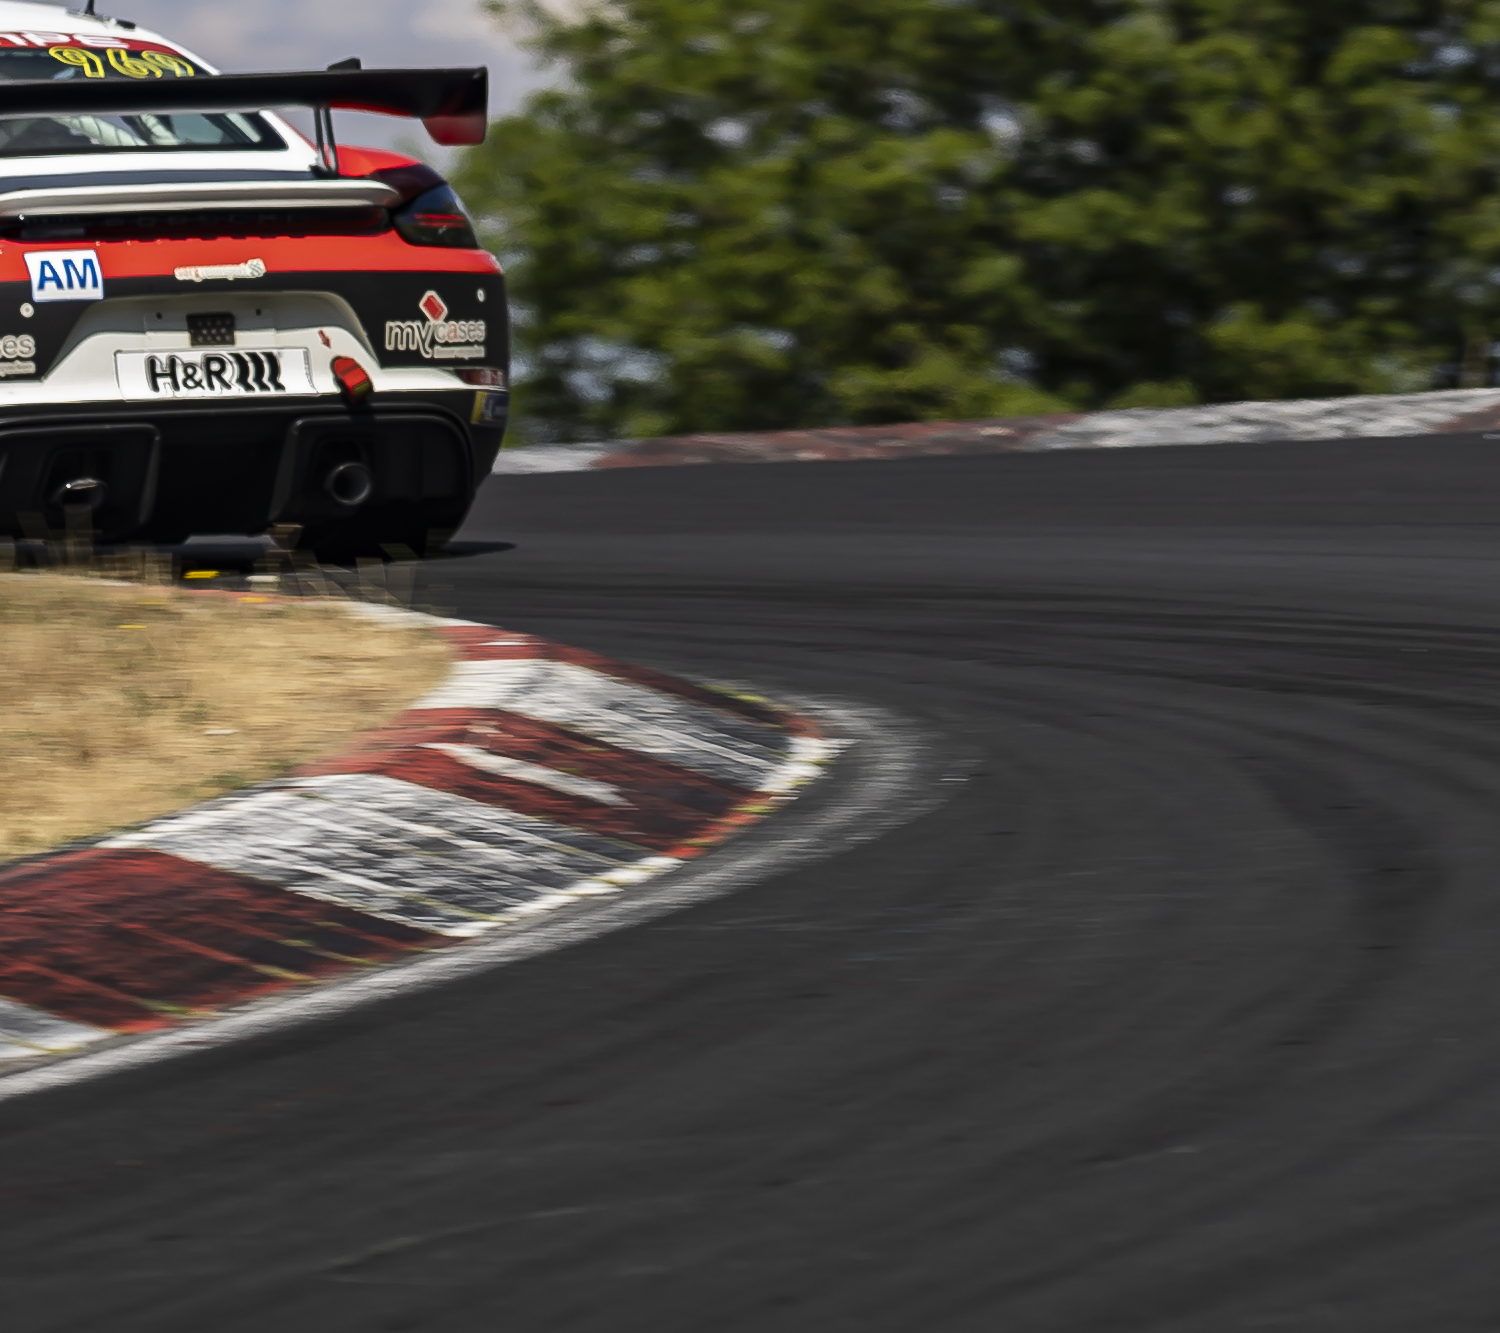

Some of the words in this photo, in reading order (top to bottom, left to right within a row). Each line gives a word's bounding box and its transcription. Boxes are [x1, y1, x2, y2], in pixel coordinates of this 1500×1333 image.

[49, 46, 195, 79] 969
[37, 258, 99, 291] AM
[147, 353, 233, 394] H&R
